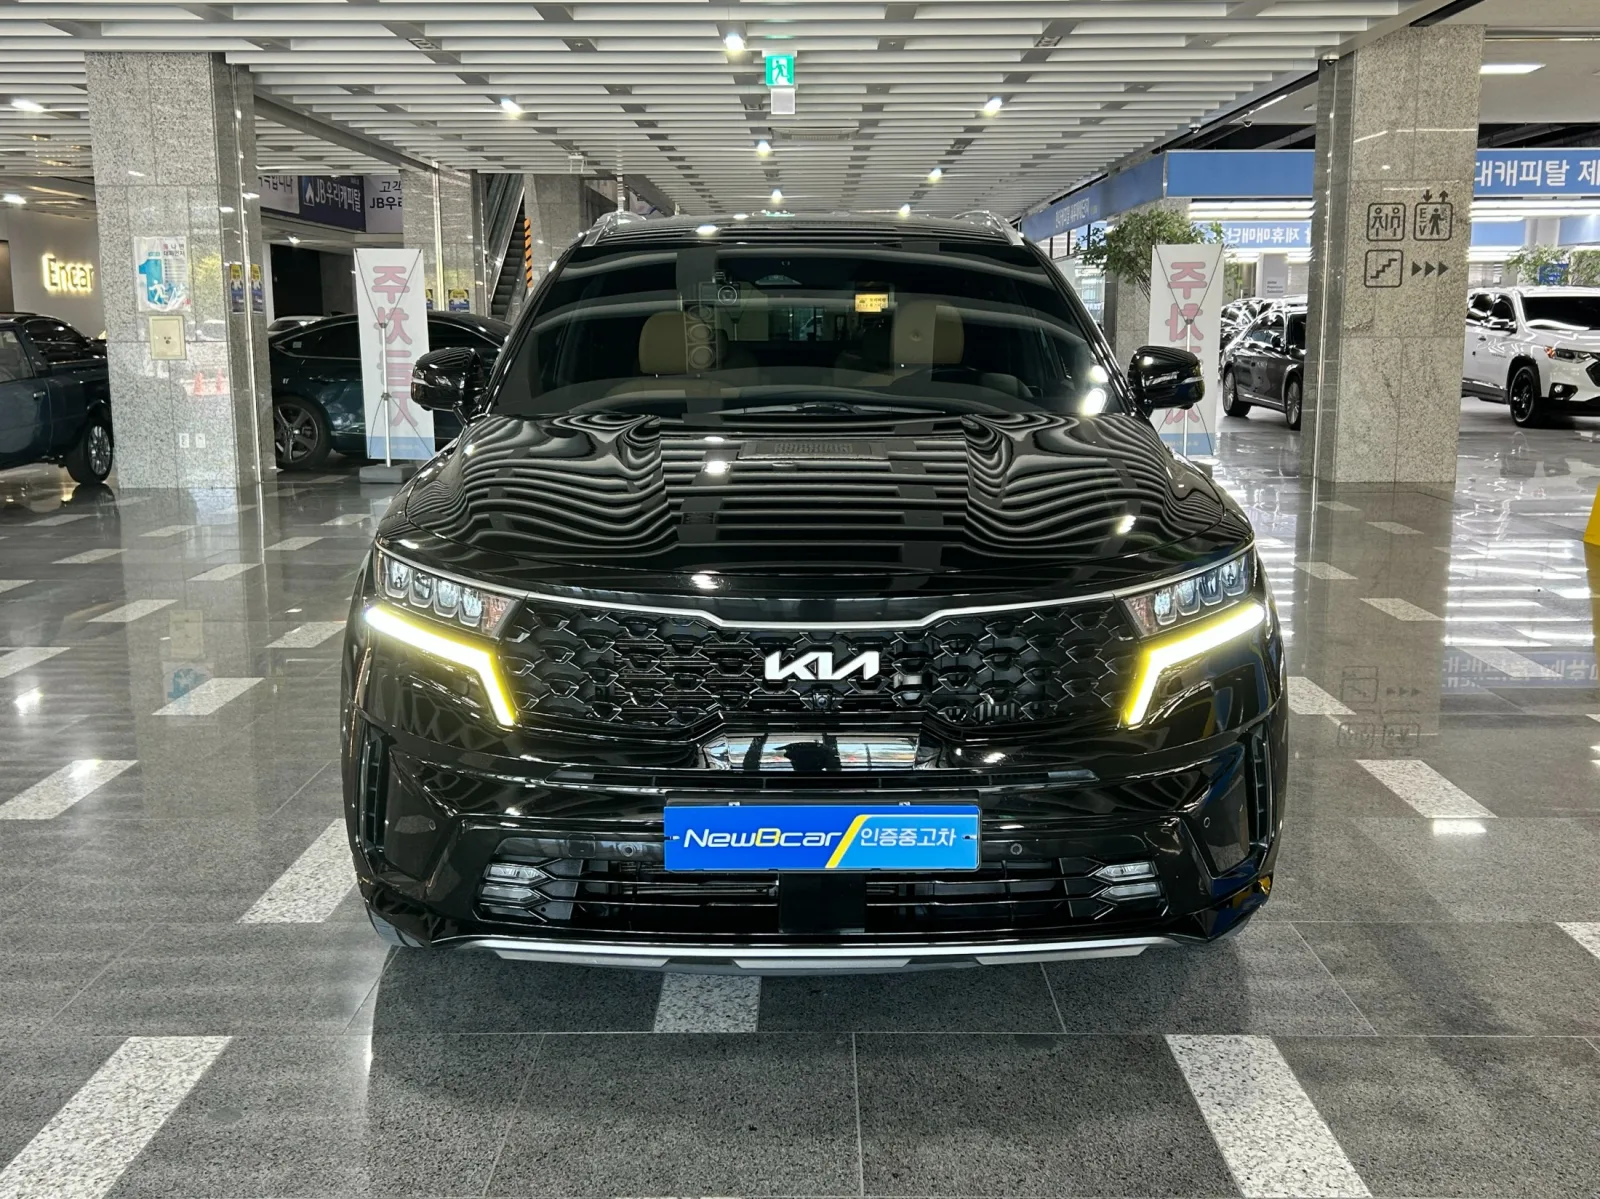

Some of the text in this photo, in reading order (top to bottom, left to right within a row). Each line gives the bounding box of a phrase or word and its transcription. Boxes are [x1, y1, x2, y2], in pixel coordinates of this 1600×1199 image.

[315, 178, 361, 213] JB우리캐피탈
[43, 254, 94, 291] Encar
[764, 650, 880, 680] KIA
[683, 827, 956, 848] NewBcar 인증중고차
